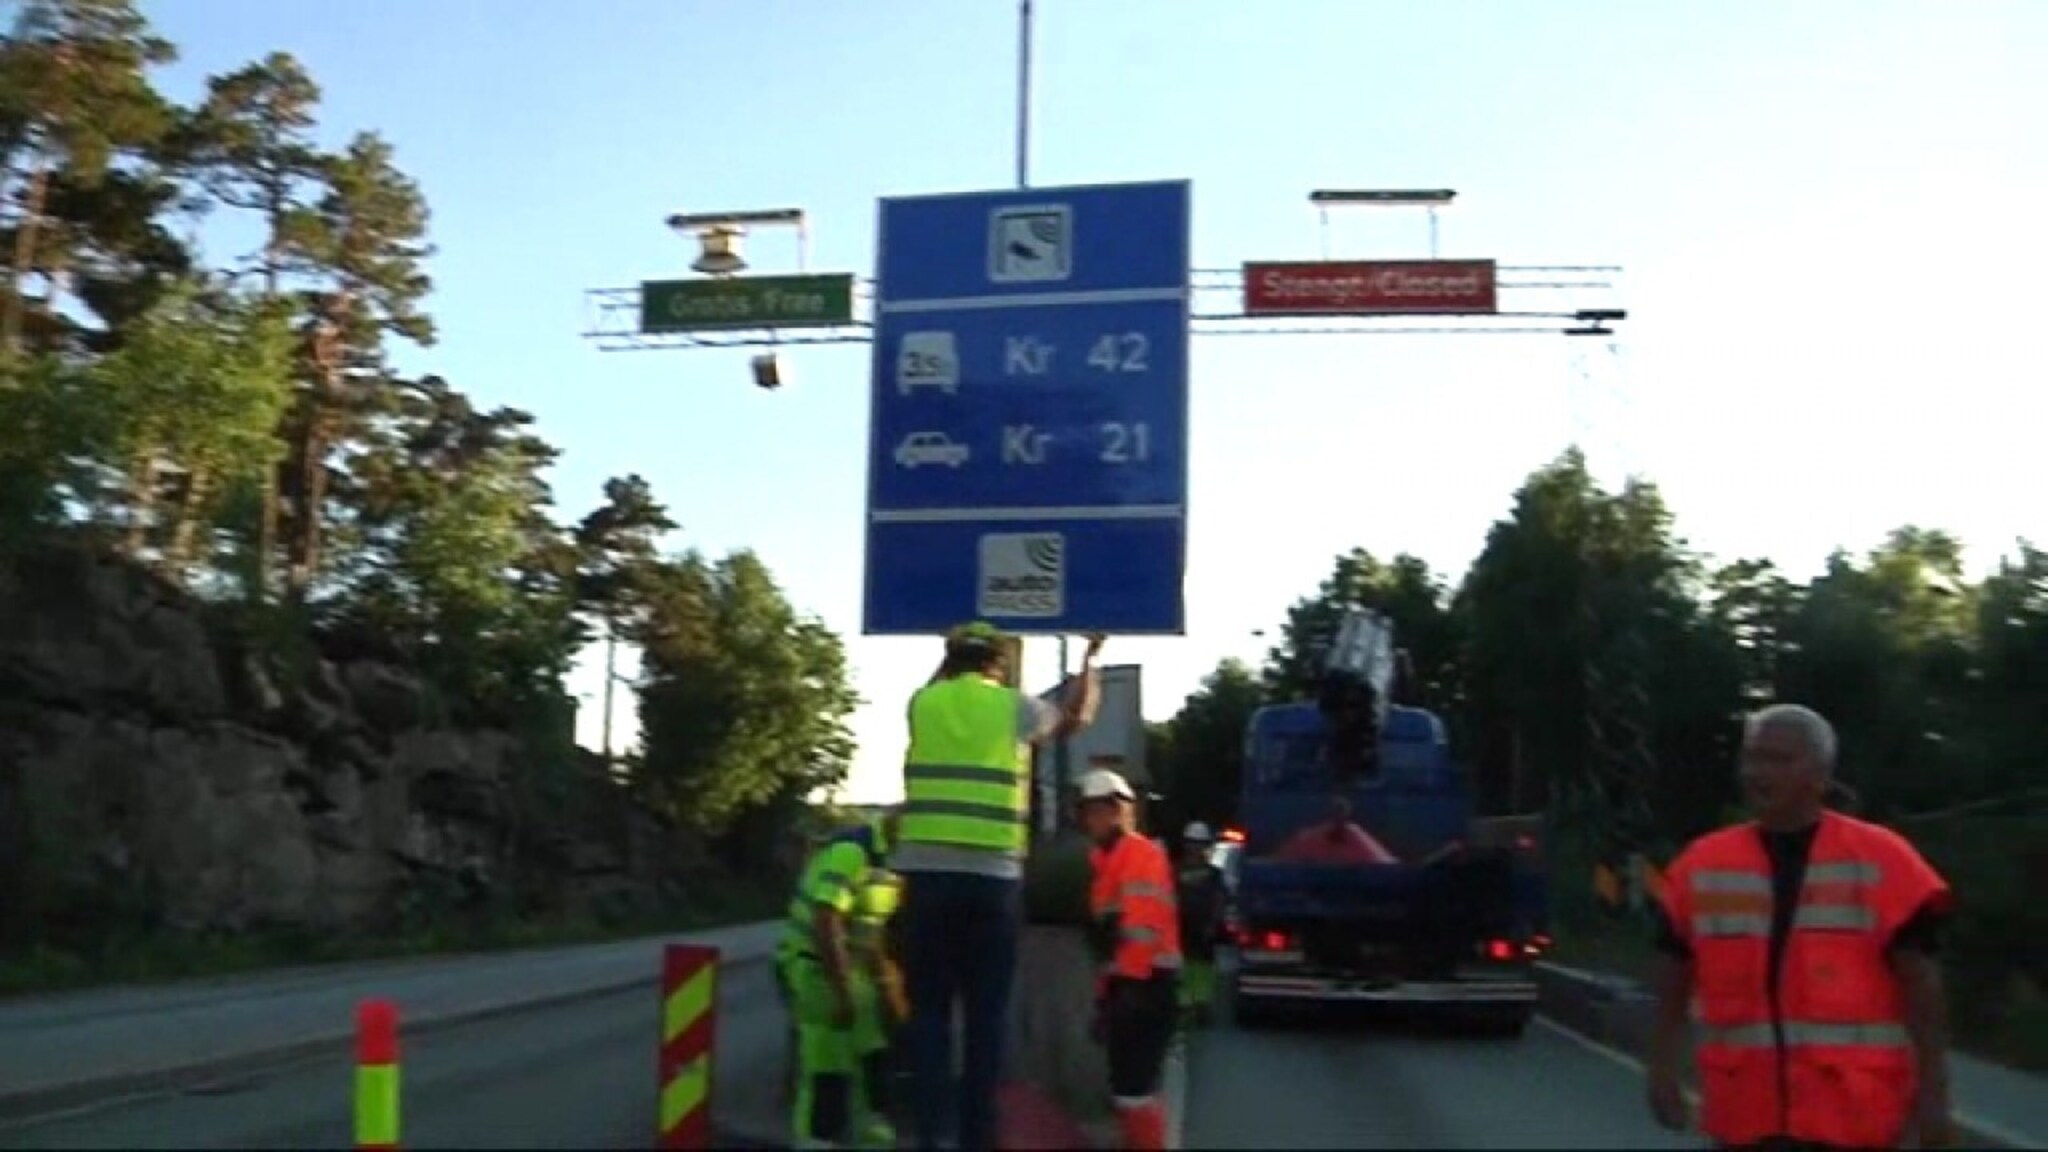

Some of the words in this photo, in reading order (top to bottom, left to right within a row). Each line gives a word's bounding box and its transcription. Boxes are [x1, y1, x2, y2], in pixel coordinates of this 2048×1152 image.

[1005, 335, 1054, 374] Kr
[1087, 330, 1148, 372] 42
[1002, 423, 1051, 464] Kr
[1100, 421, 1148, 462] 21
